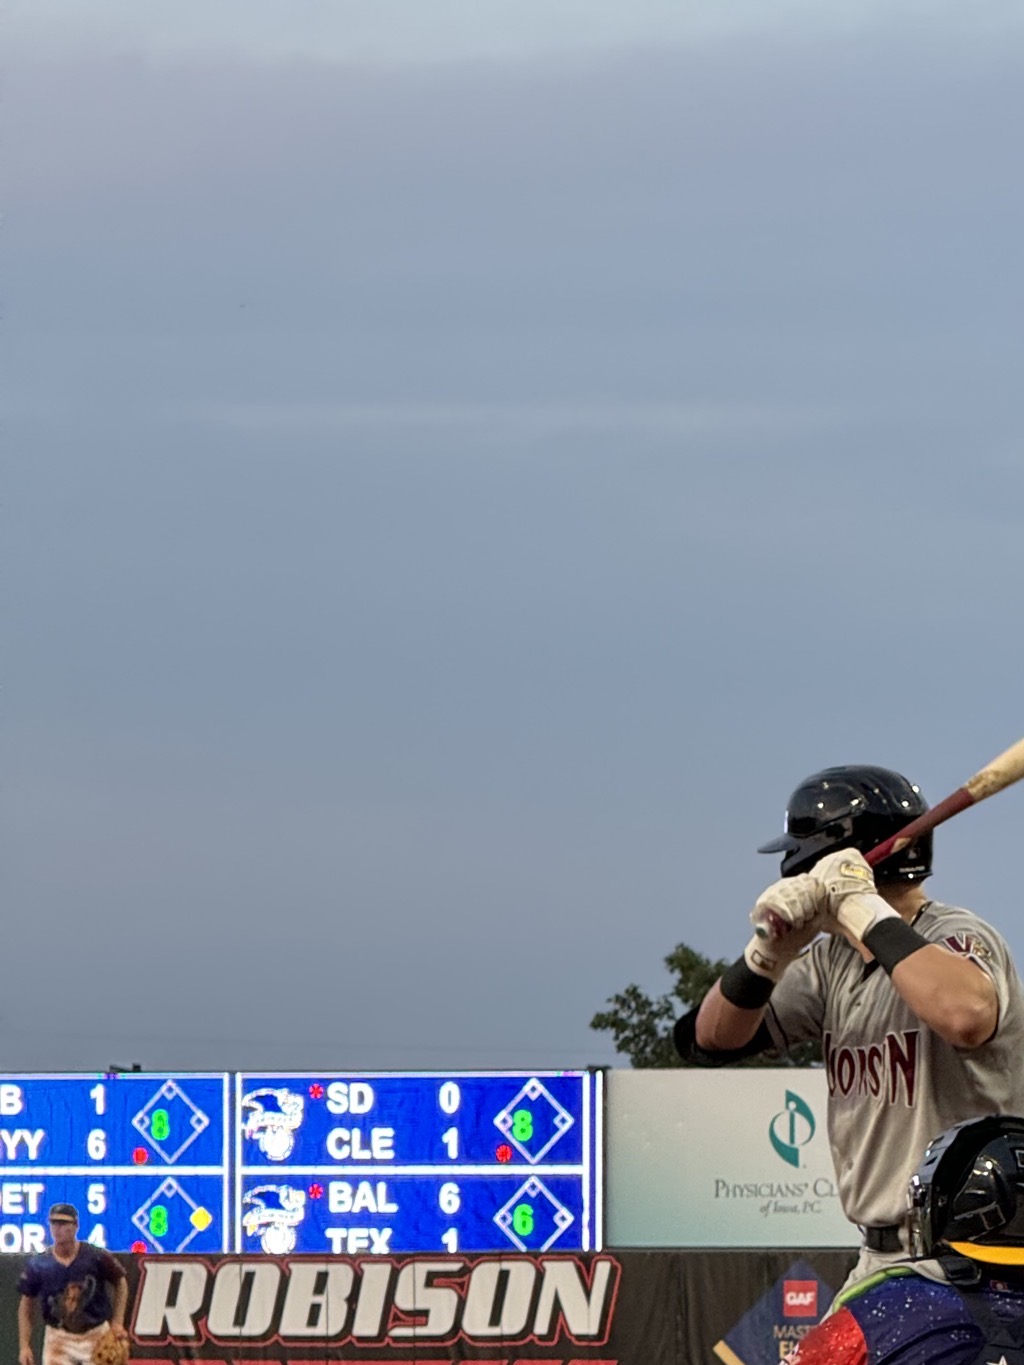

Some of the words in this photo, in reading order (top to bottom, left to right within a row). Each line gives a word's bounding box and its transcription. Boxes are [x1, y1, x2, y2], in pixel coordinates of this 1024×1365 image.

[0, 1084, 23, 1115] B
[89, 1084, 106, 1115] 1
[326, 1083, 374, 1114] SD
[438, 1082, 460, 1114] 0
[151, 1109, 170, 1140] 8
[512, 1110, 533, 1141] 8
[0, 1129, 45, 1160] YY
[87, 1129, 107, 1160] 6
[326, 1128, 395, 1160] CLE
[442, 1127, 459, 1159] 1
[1, 1183, 45, 1214] ET
[87, 1183, 106, 1214] 5
[328, 1181, 398, 1213] BAL
[438, 1182, 461, 1214] 6
[150, 1205, 168, 1237] 8
[512, 1204, 534, 1236] 6
[0, 1223, 46, 1253] OR
[88, 1223, 106, 1249] 4
[441, 1228, 458, 1253] 1
[133, 1261, 612, 1337] ROBISON
[785, 1292, 815, 1306] GAF
